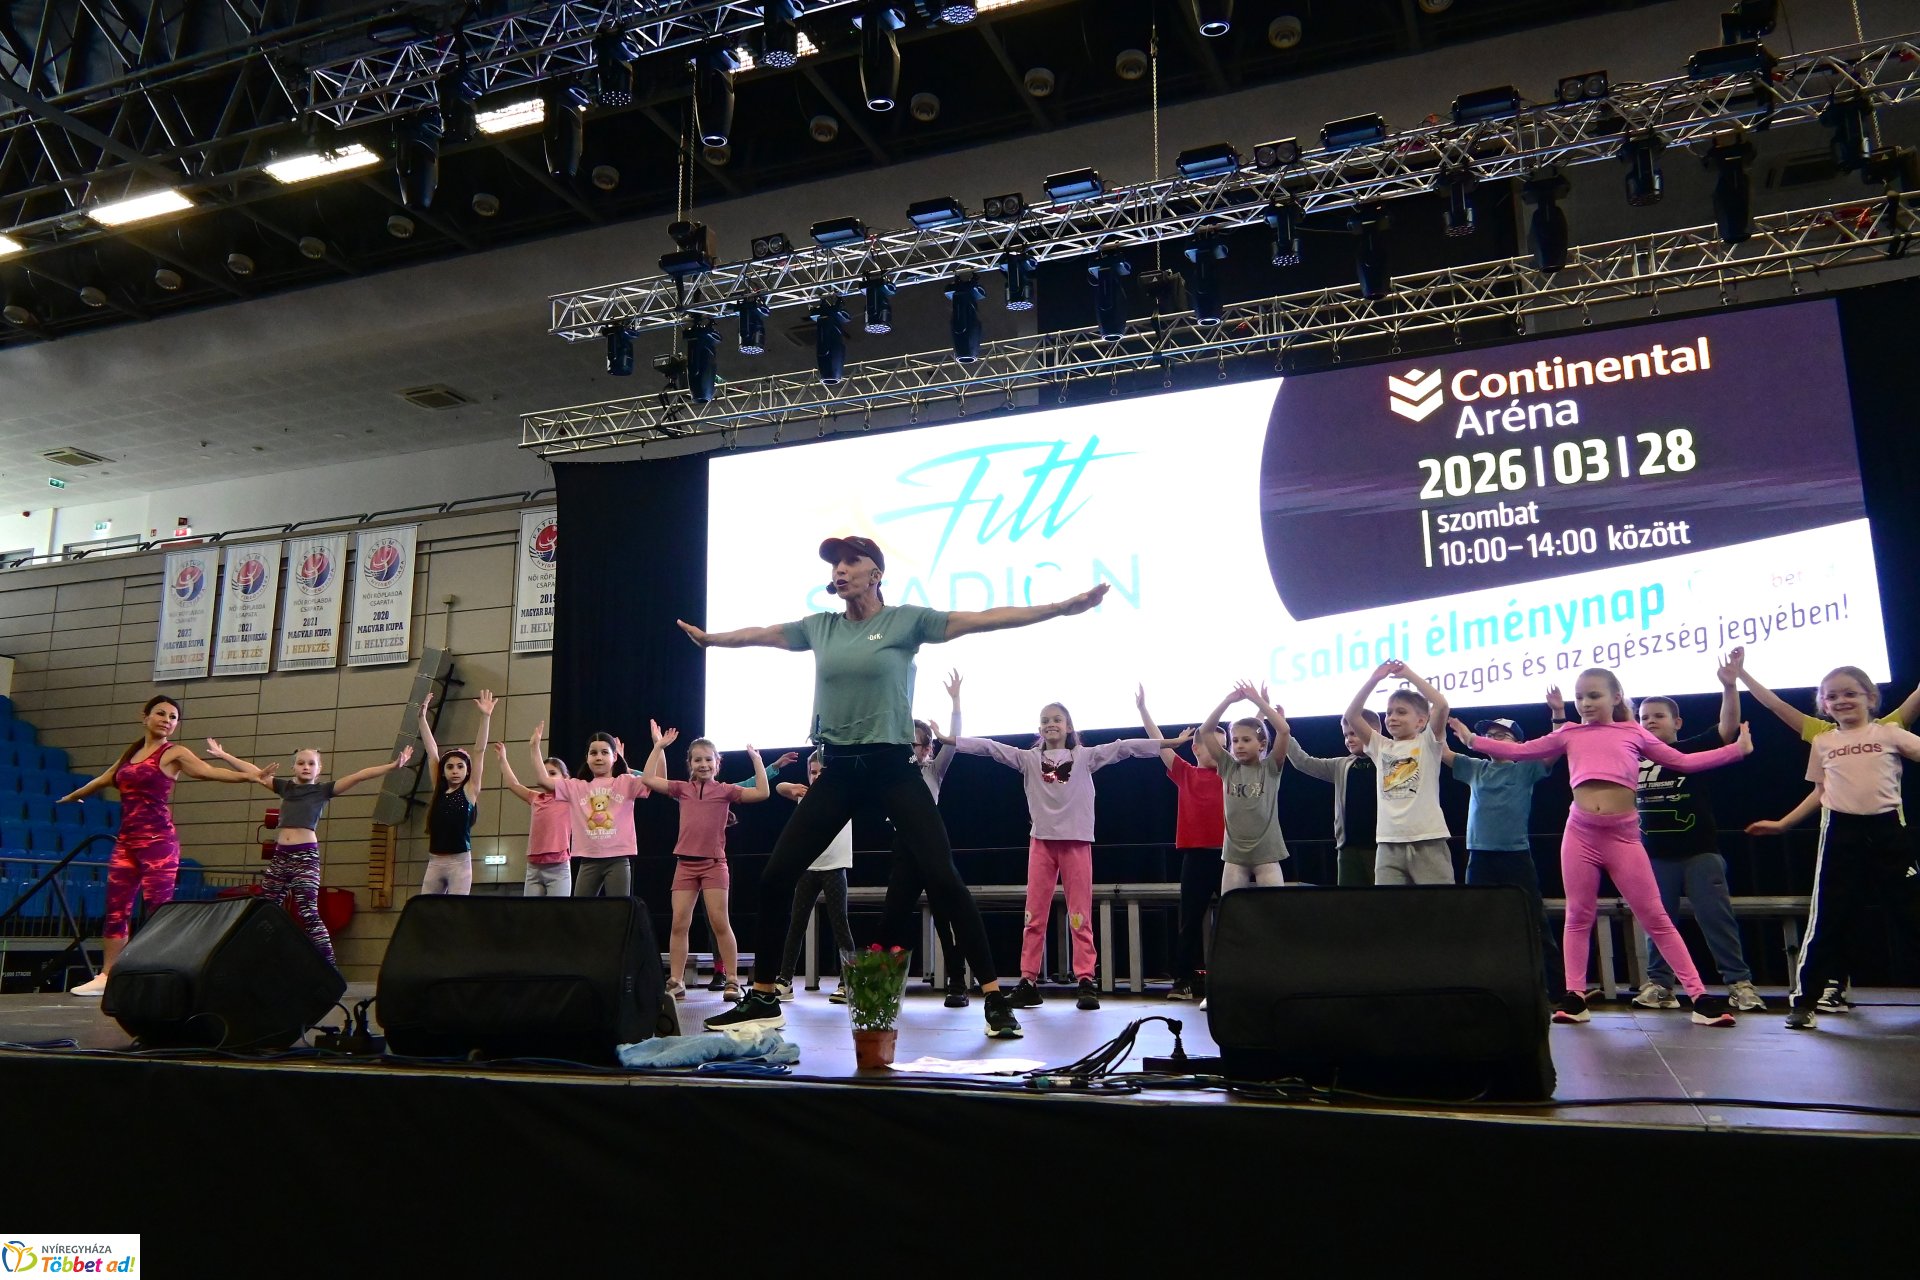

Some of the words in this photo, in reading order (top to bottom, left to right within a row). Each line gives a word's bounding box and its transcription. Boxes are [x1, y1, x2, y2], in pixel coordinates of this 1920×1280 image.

[1451, 336, 1711, 402] Continental
[1455, 399, 1579, 439] Aréna
[1437, 501, 1539, 534] szombat
[1608, 520, 1691, 552] között
[372, 610, 390, 621] 2020
[520, 606, 544, 618] MAGYAR
[287, 629, 313, 640] MAGYAR
[314, 627, 332, 638] KUPA
[356, 623, 385, 634] MAGYAR
[385, 621, 404, 632] KUPA
[1269, 619, 1411, 686] Családi
[1426, 582, 1665, 657] élménynap
[1522, 652, 1547, 677] és
[1556, 650, 1583, 671] az
[1593, 622, 1708, 669] egészség
[1718, 593, 1849, 649] jegyében!
[292, 640, 331, 655] HELYEZÉS
[364, 633, 405, 649] HELYEZÉS
[1827, 742, 1883, 760] adidas
[1676, 776, 1687, 788] 7
